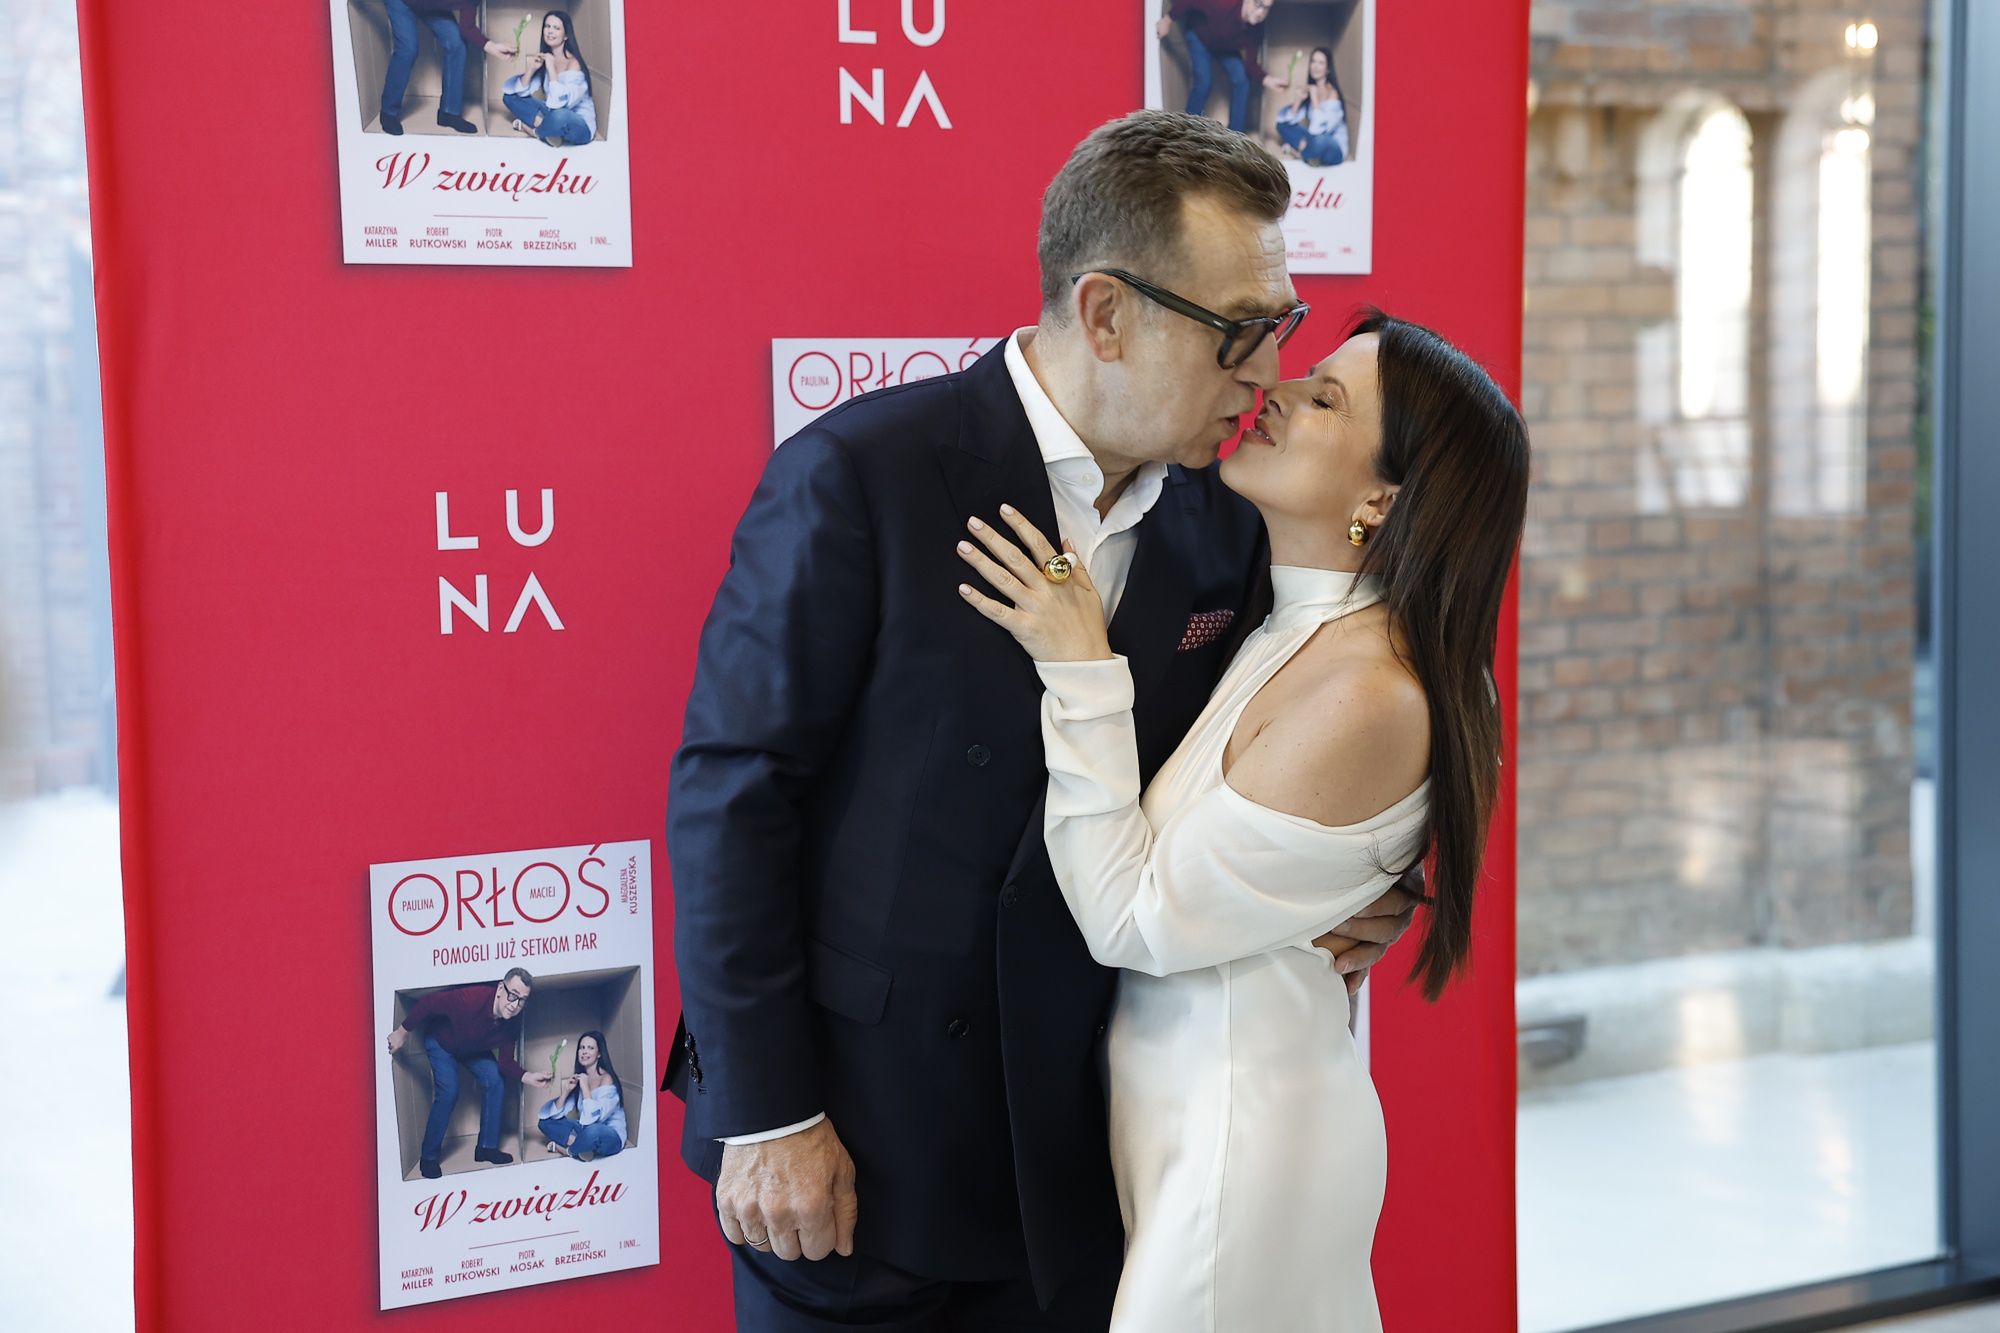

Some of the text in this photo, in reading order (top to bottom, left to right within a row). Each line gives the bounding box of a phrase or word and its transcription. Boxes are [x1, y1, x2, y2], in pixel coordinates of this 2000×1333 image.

[376, 151, 599, 202] W związku
[364, 226, 398, 236] KATARZYNA
[426, 227, 449, 237] ROBERT
[485, 228, 503, 238] PIOTR
[365, 238, 577, 251] MILLER RUTKOWSKI MOSAK BRZEZIŃSKI
[801, 375, 830, 386] PAULINA
[435, 488, 555, 551] LU
[388, 843, 610, 936] ORŁOŚ
[529, 886, 556, 900] MACIEJ
[620, 867, 628, 904] MAGDALENA
[628, 855, 638, 915] KUSZEWSKA
[402, 898, 435, 912] PAULINA
[433, 932, 598, 967] POMOGLI JUŻ SETKOM PAR
[414, 1169, 629, 1233] W związku
[401, 1240, 591, 1280] KATARZYNA ROBERT PIOTR MIŁOSZ
[402, 1249, 607, 1291] MILLER RUTKOWSKI MOSAK BRZEZIŃSKI
